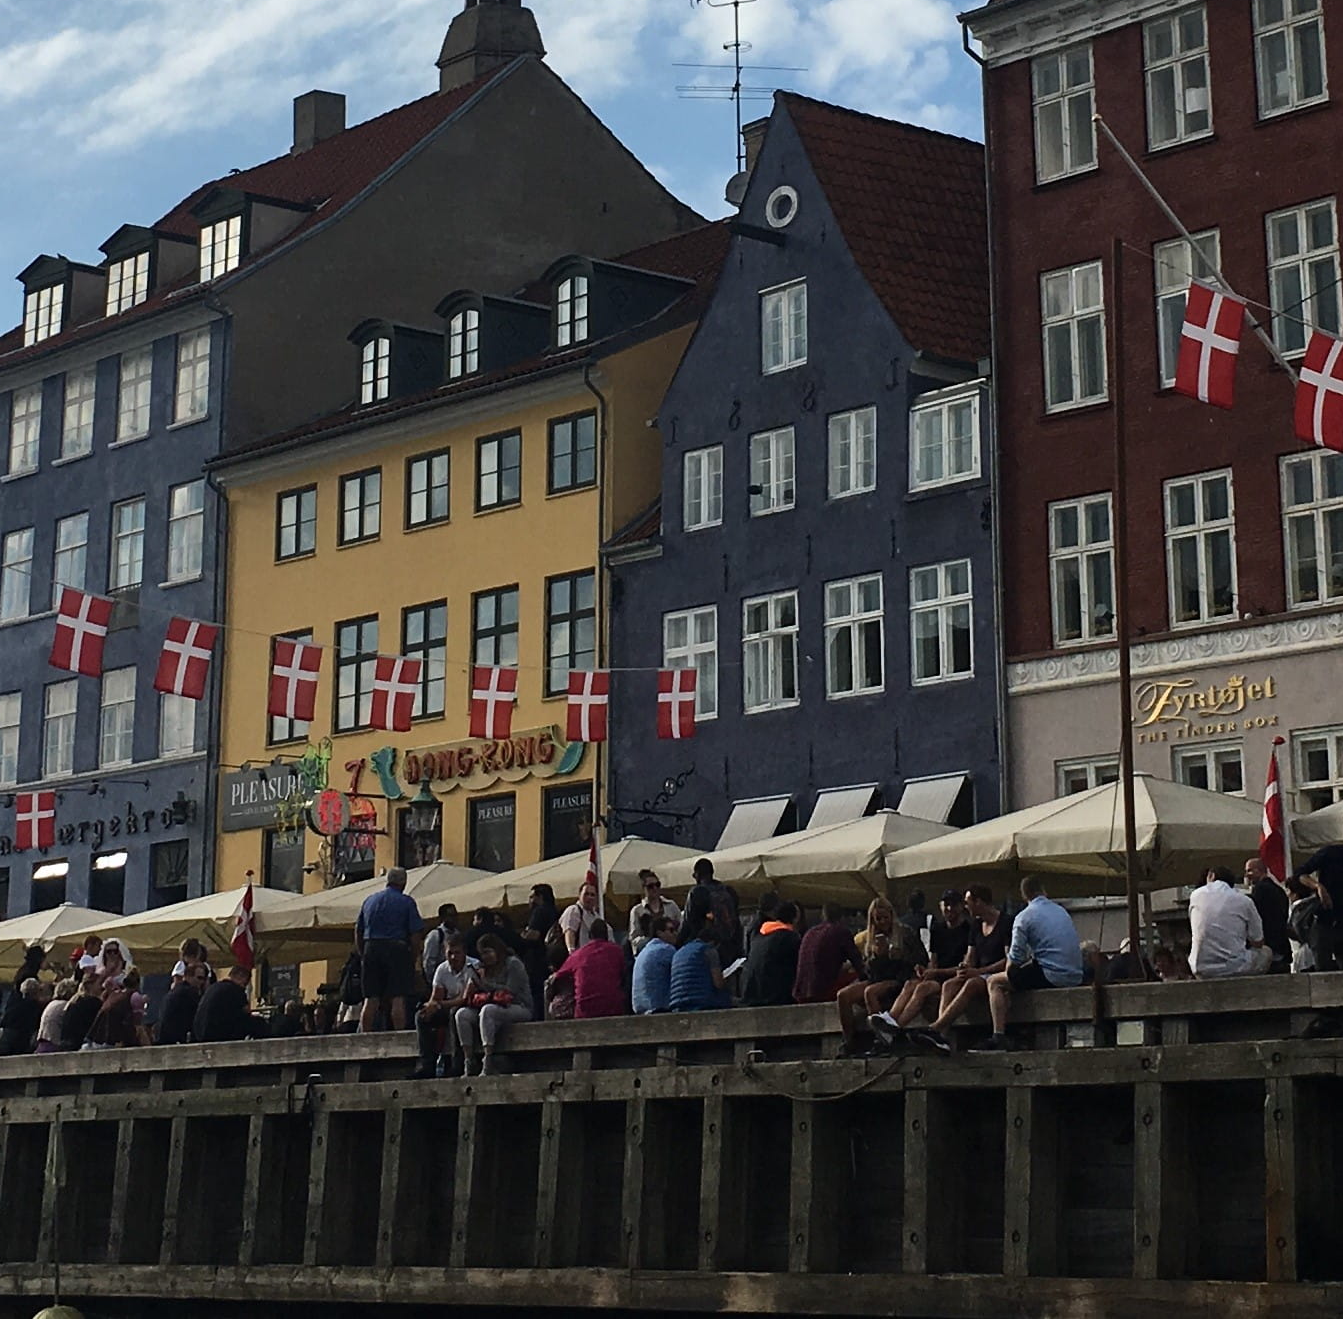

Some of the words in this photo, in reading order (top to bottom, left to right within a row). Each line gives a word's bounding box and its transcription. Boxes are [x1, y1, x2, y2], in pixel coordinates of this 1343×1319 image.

[1138, 731, 1168, 744] THE
[1244, 715, 1279, 731] BOX
[552, 793, 591, 810] PLEASURE
[477, 804, 513, 820] PLEASURE
